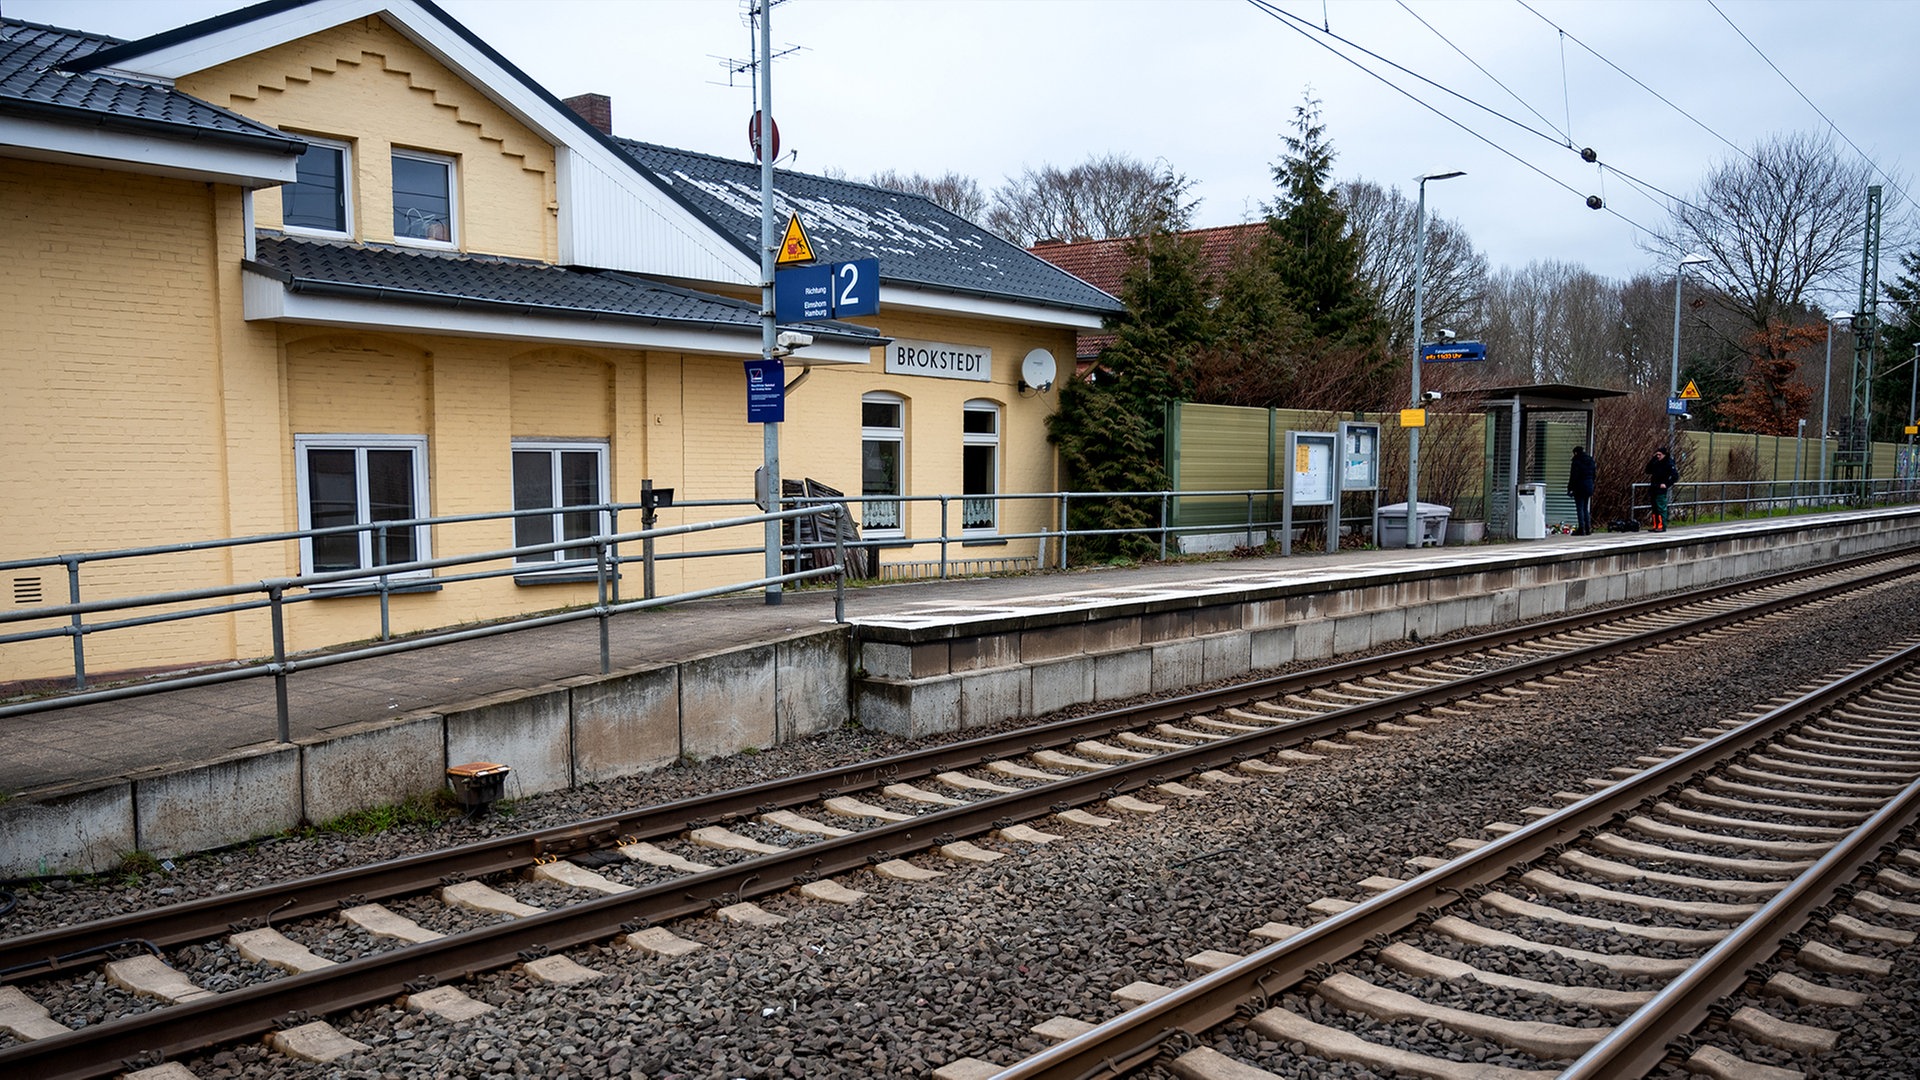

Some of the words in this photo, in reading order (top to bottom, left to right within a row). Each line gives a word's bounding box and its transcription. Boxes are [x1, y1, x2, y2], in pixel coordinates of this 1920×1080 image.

[840, 263, 859, 306] 2
[805, 287, 827, 295] Richtung
[804, 300, 827, 309] Elmshorn
[804, 309, 827, 317] Hamburg
[897, 346, 982, 373] BROKSTEDT
